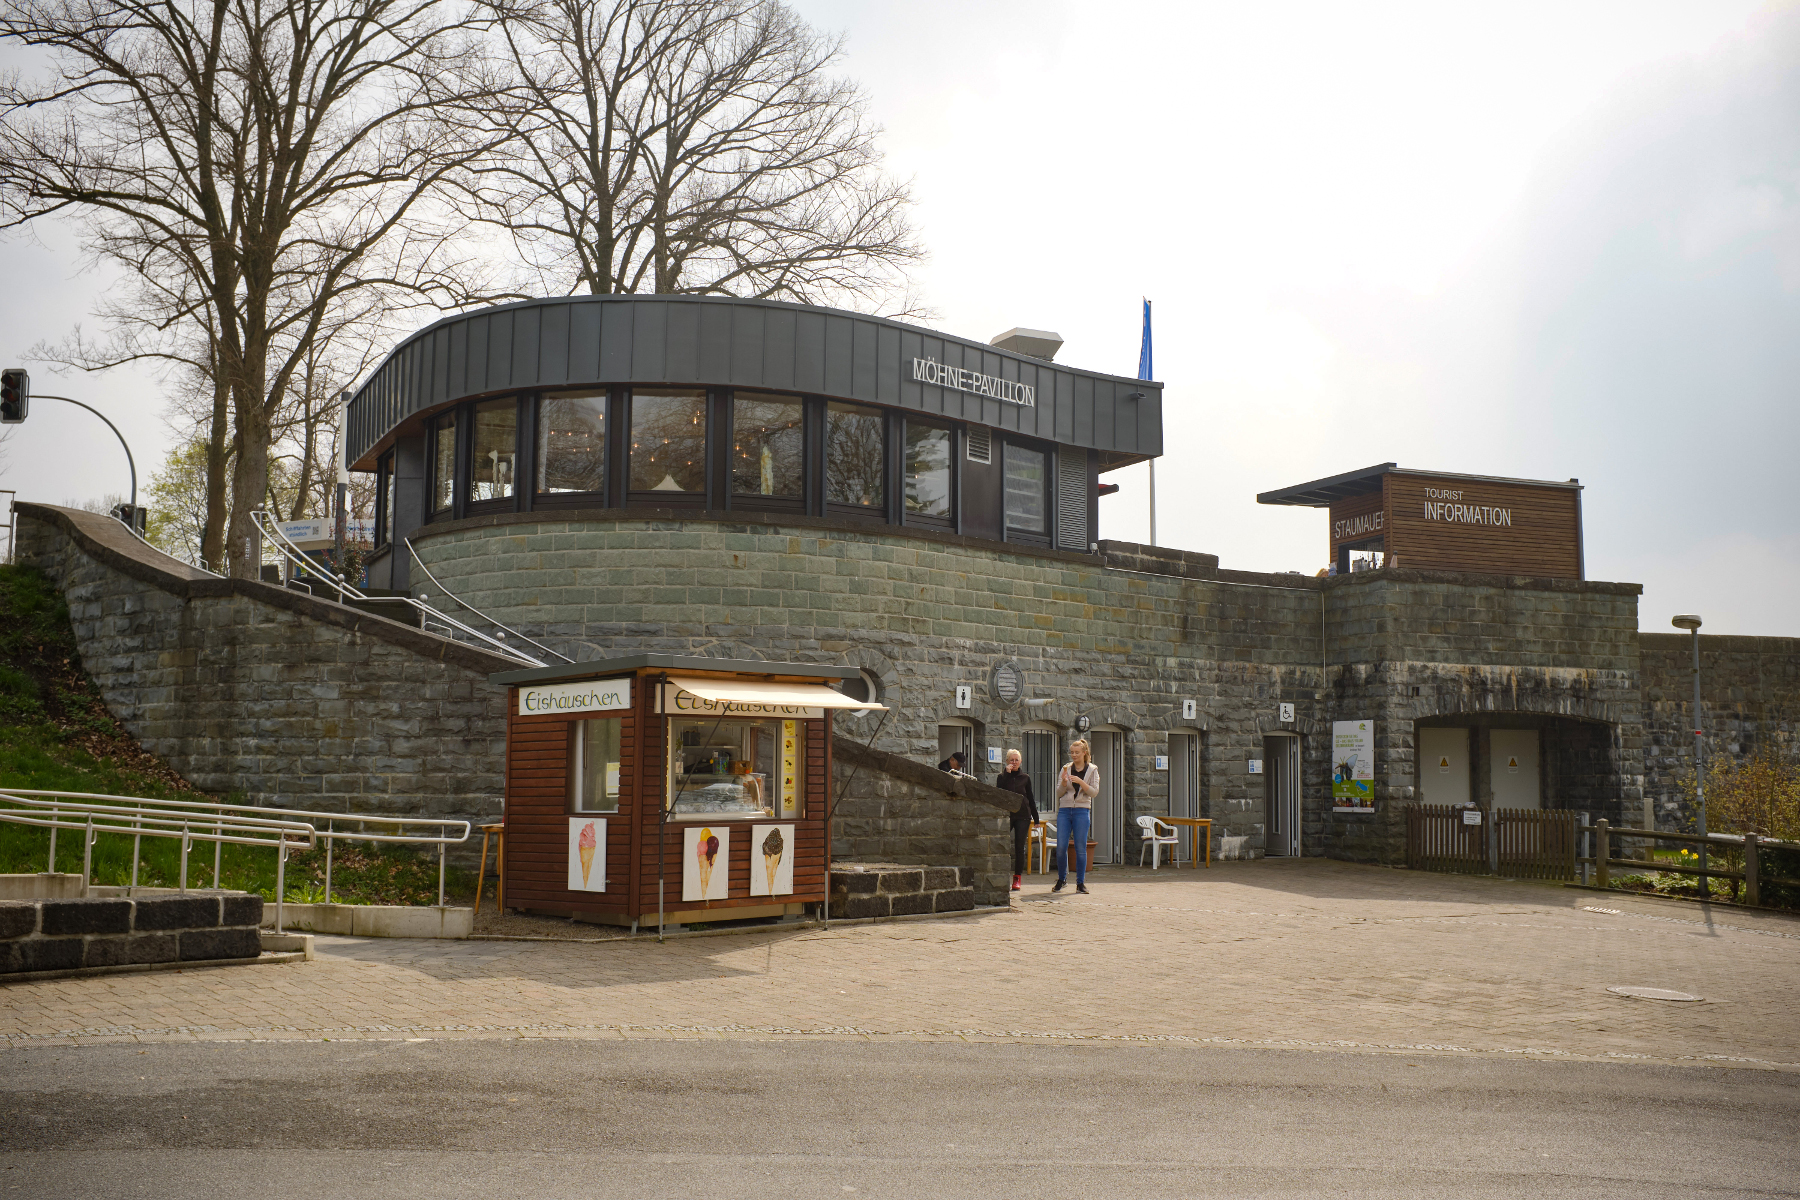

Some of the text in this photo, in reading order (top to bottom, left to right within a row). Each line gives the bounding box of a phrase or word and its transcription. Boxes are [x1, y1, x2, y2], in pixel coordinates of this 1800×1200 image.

[913, 356, 1035, 407] MÖHNE-PAVILLON
[1424, 487, 1464, 501] TOURIST
[1424, 501, 1511, 527] INFORMATION
[525, 690, 622, 711] Eishäuschen
